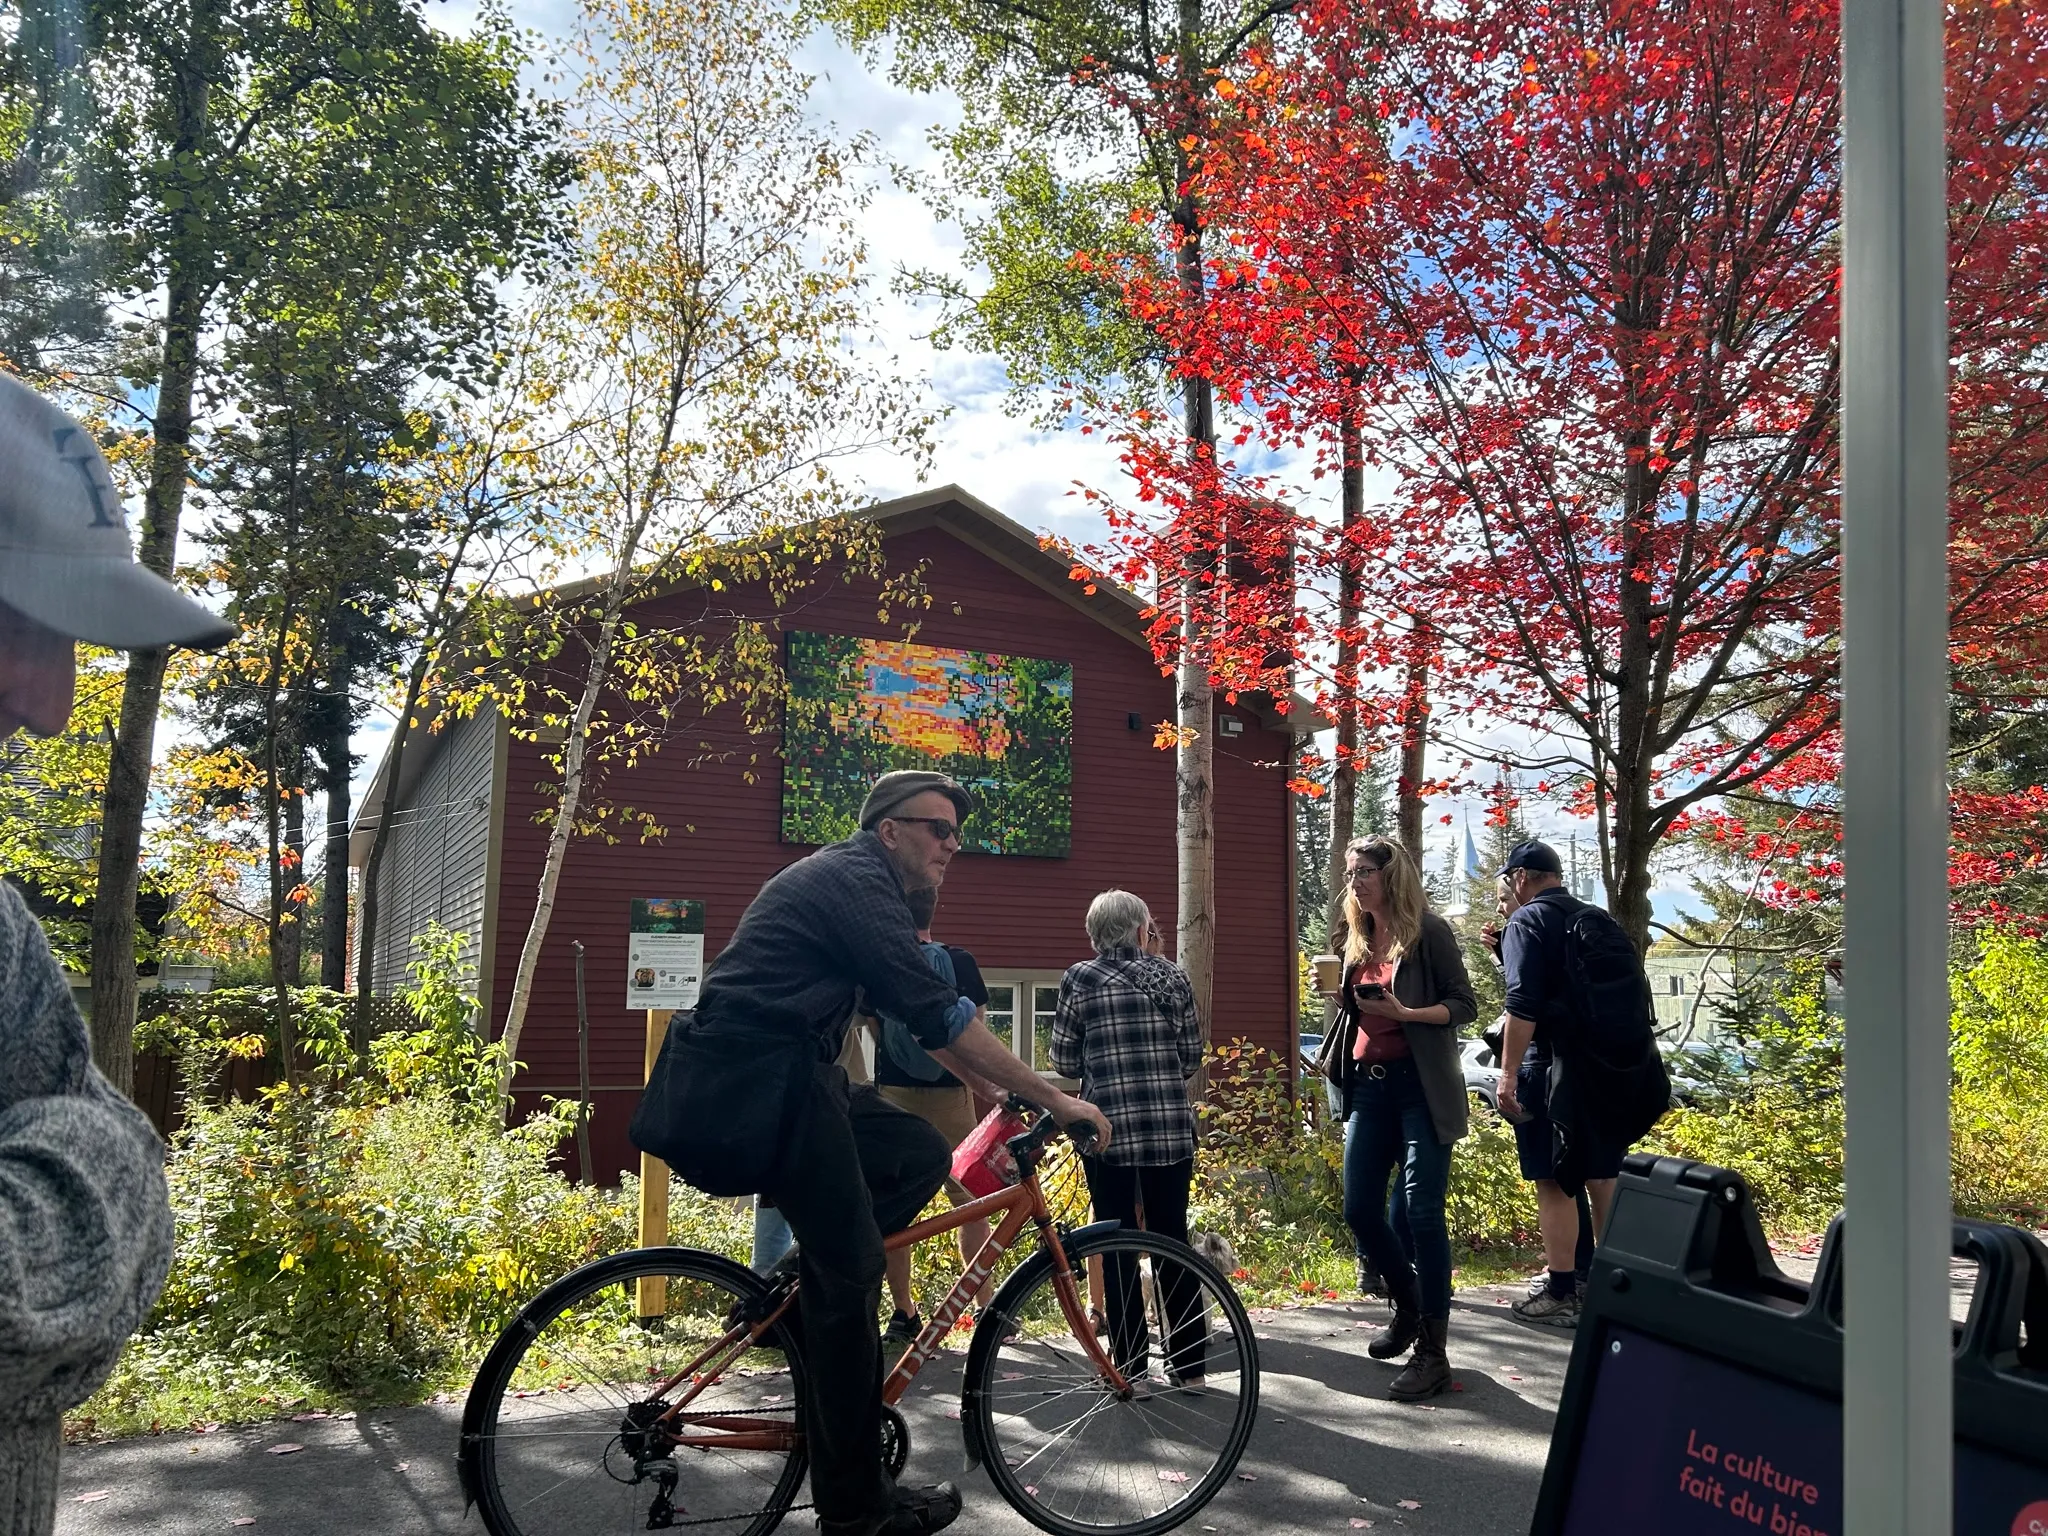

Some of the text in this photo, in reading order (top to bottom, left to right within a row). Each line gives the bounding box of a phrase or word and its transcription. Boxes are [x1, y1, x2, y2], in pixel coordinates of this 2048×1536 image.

[1680, 1466, 1725, 1508] fait
[1730, 1491, 1764, 1525] du
[1687, 1429, 1819, 1504] La culture
